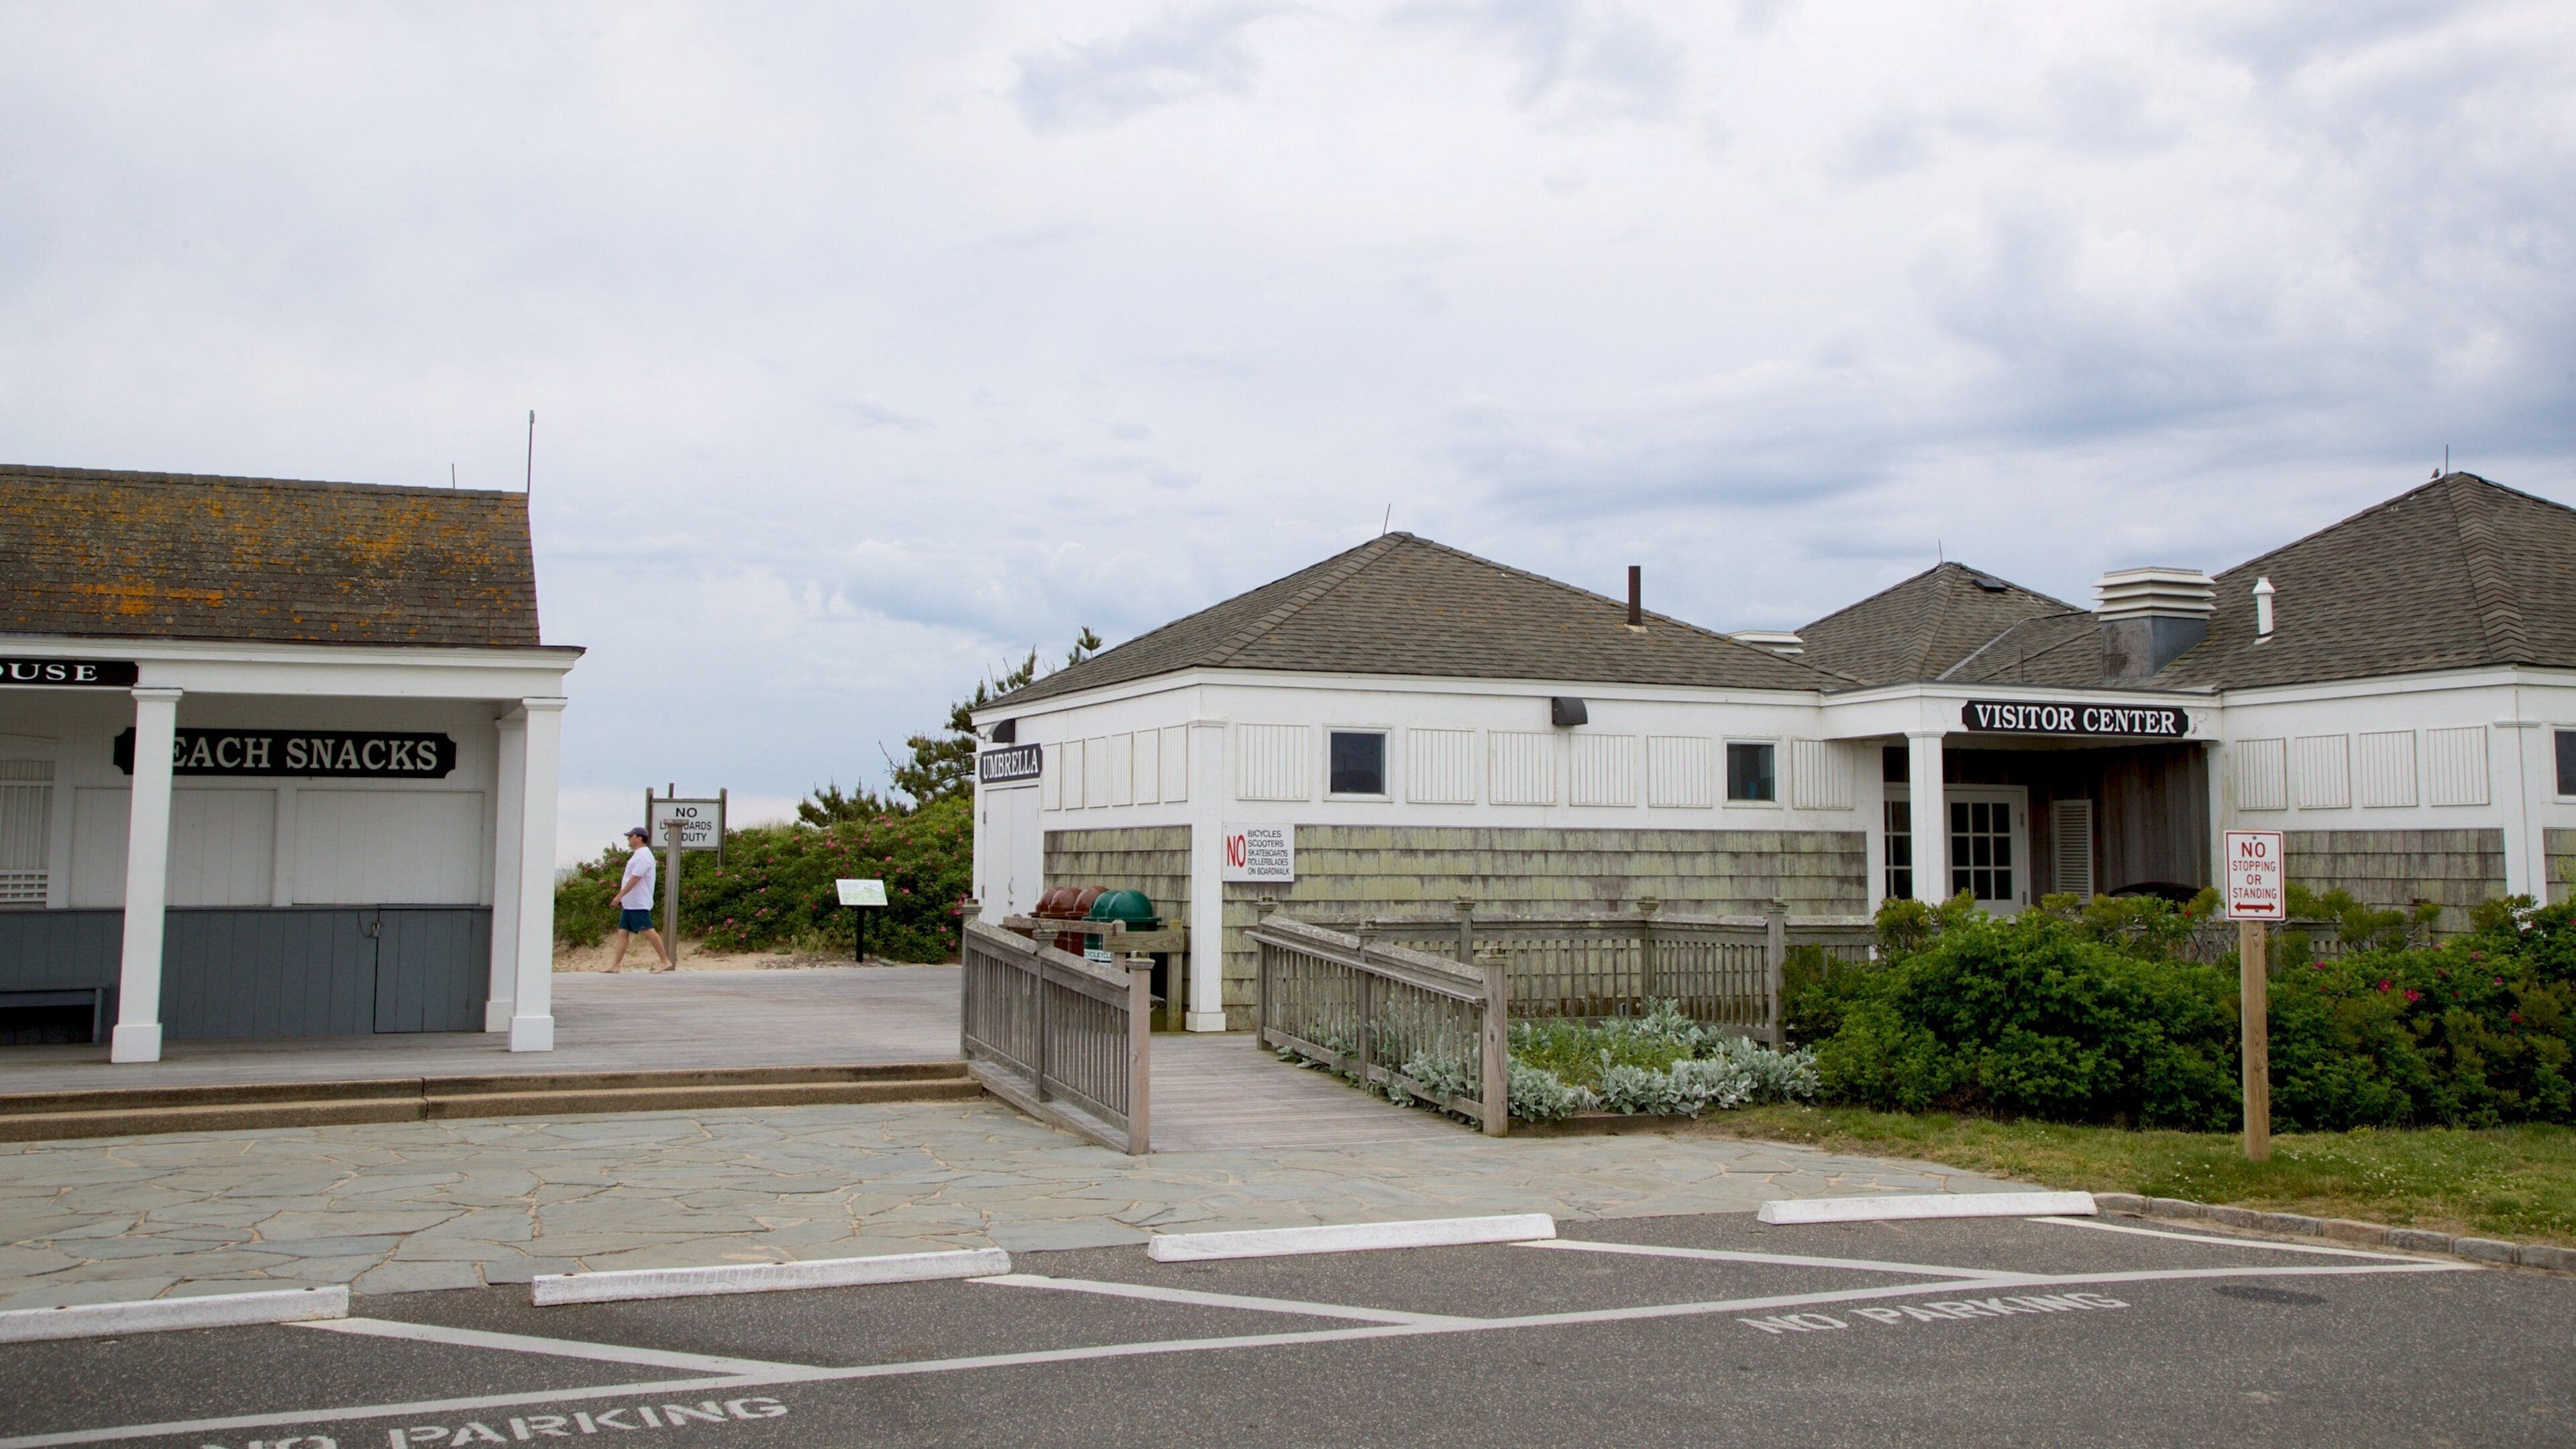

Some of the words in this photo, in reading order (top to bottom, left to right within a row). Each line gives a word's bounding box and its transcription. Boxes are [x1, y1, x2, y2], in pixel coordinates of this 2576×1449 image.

[0, 663, 98, 682] USE
[1974, 704, 2076, 731] VISITOR
[2083, 708, 2176, 734] CENTER
[173, 737, 272, 768] EACH
[286, 738, 437, 771] SNACKS
[983, 749, 1039, 780] UMBRELLA
[676, 808, 698, 818] NO
[682, 833, 707, 842] DUTY
[1248, 829, 1282, 838] BICYCLES
[1248, 839, 1284, 847] SCOOTERS
[1226, 835, 1246, 867] NO
[1248, 849, 1288, 857] SKATEBOARDS
[2241, 842, 2265, 858] NO
[1248, 858, 1289, 866] ROLLERBLADES
[2233, 861, 2275, 871] STOPPING
[1248, 867, 1256, 875] ON
[1257, 867, 1290, 875] BOARDWALK
[2247, 874, 2261, 885] OR
[2233, 888, 2277, 899] STANDING
[1737, 1313, 1847, 1334] NO
[1848, 1293, 2131, 1324] PARKING
[388, 1397, 788, 1449] PARKING
